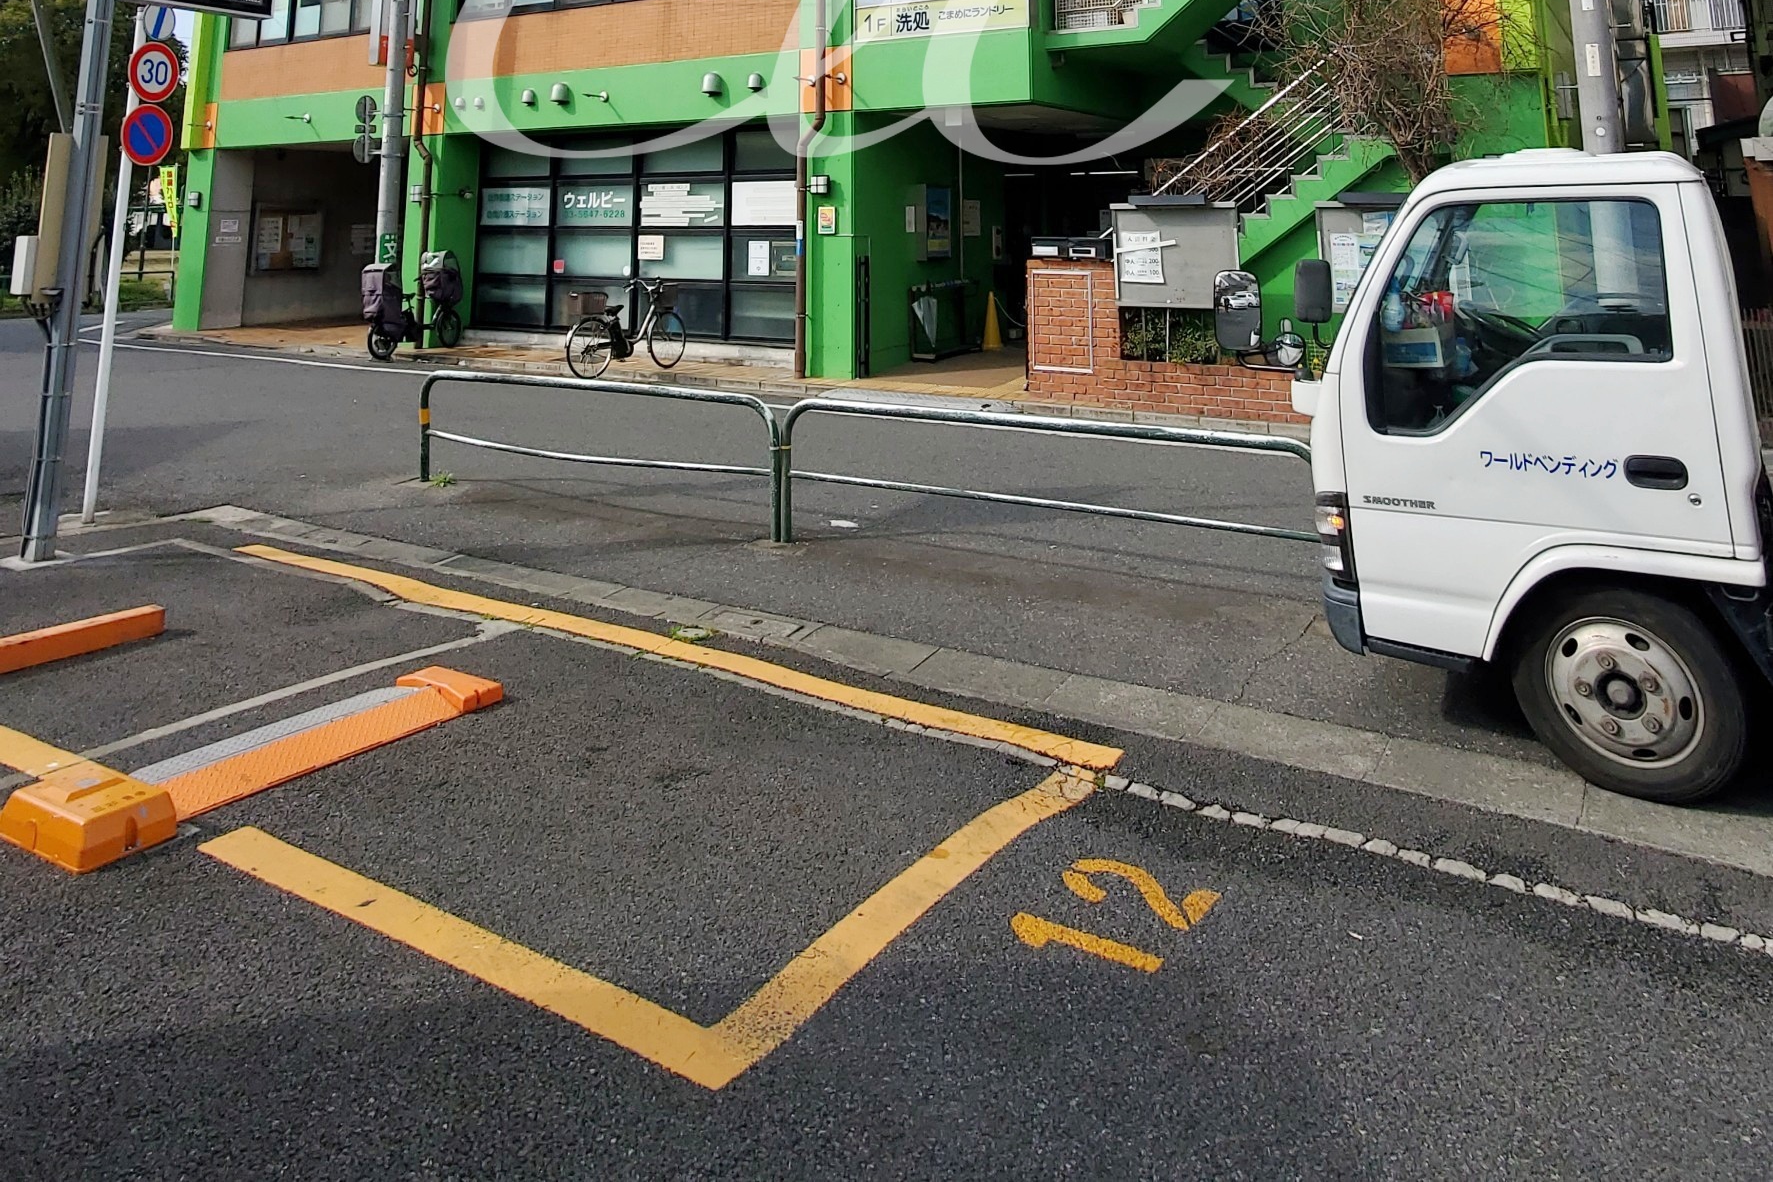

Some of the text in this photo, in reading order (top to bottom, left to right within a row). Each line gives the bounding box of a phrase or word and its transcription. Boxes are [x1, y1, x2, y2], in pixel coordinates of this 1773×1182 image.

[863, 5, 1014, 33] 1F 洗処 こまめにランドリー
[141, 58, 168, 86] 30
[563, 190, 626, 209] ウェルビー
[1480, 450, 1619, 479] ワールドベンディング
[1362, 495, 1436, 510] SMOOTHER
[1010, 858, 1222, 974] 12
